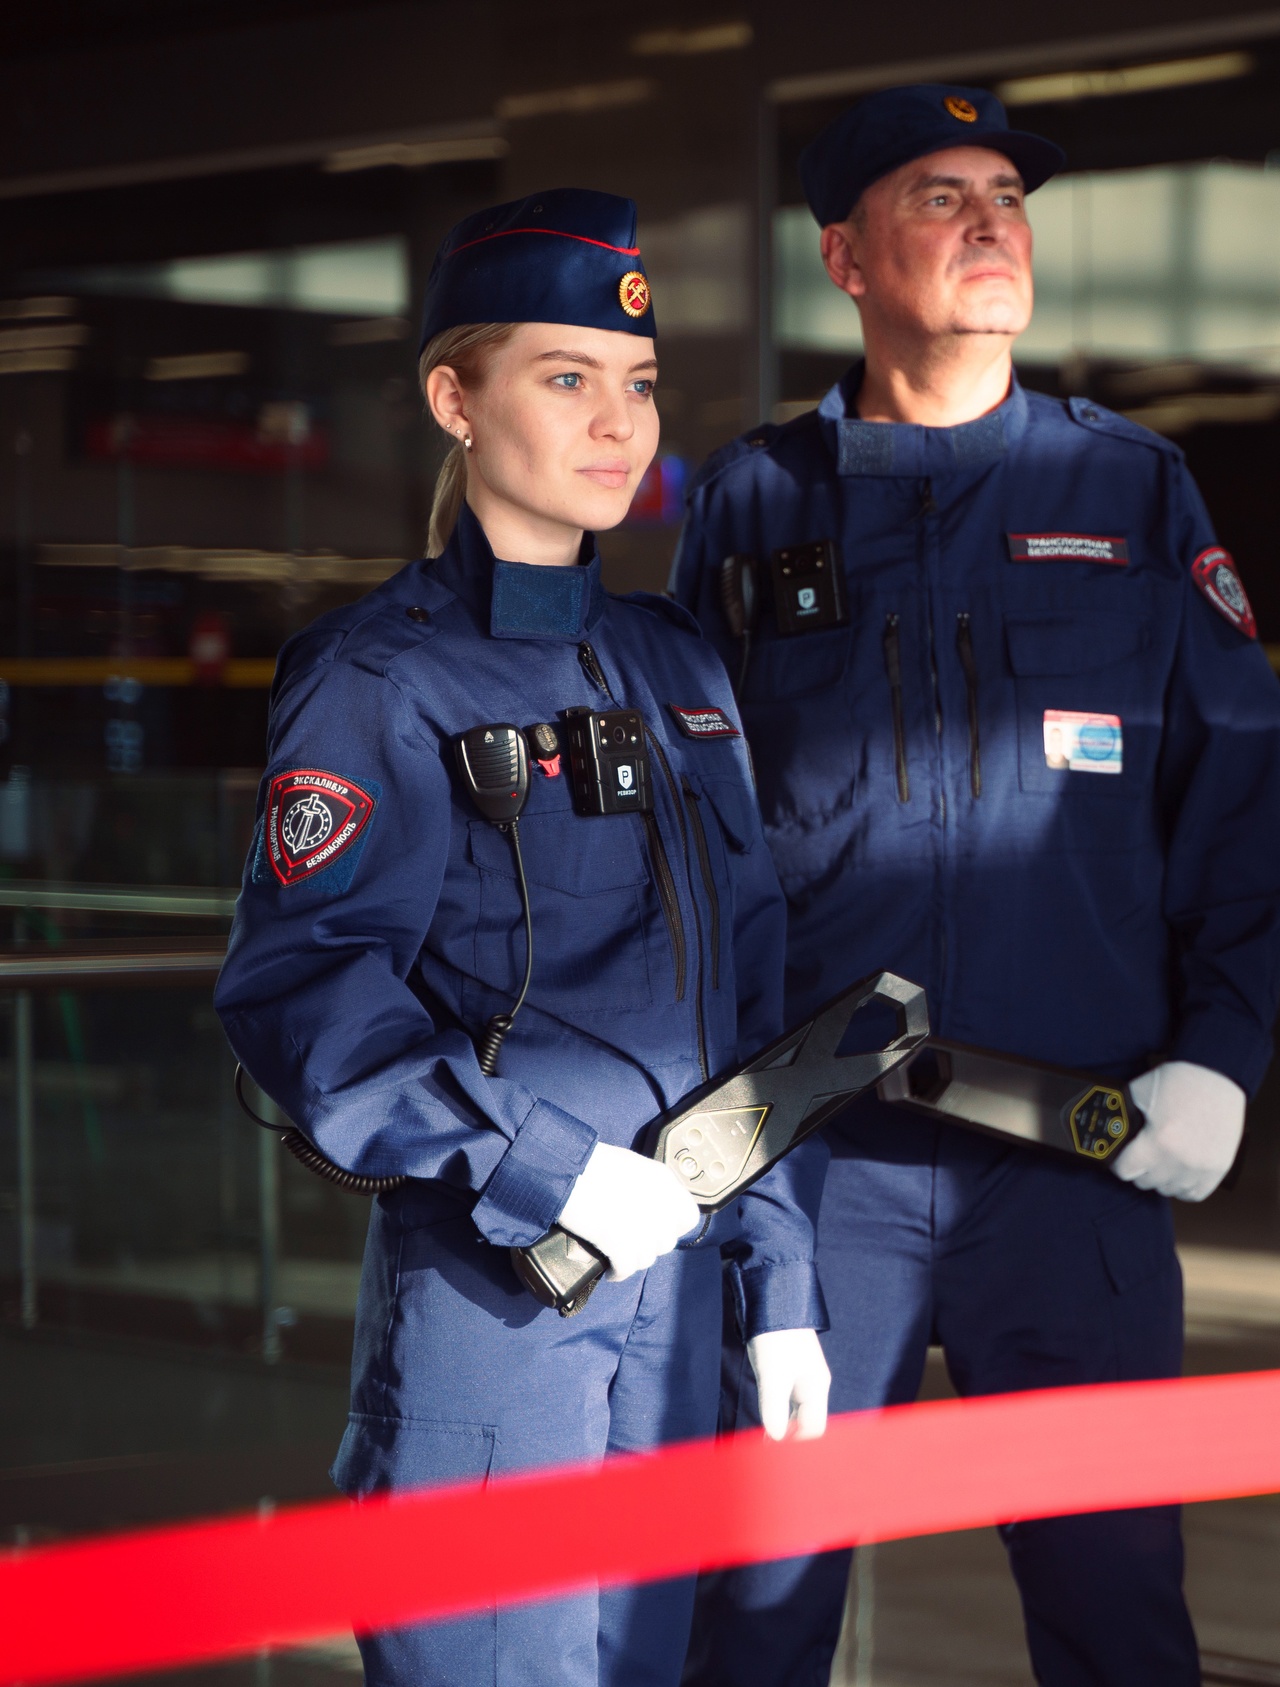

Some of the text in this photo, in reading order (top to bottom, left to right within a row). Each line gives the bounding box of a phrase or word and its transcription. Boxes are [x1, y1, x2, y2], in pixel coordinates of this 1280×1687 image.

[293, 775, 349, 795] ЭКСКАЛИБУР
[269, 805, 281, 862] ТРАНСПОРТНАЯ
[305, 822, 357, 868] БЕЗОПАСНОСТЬ
